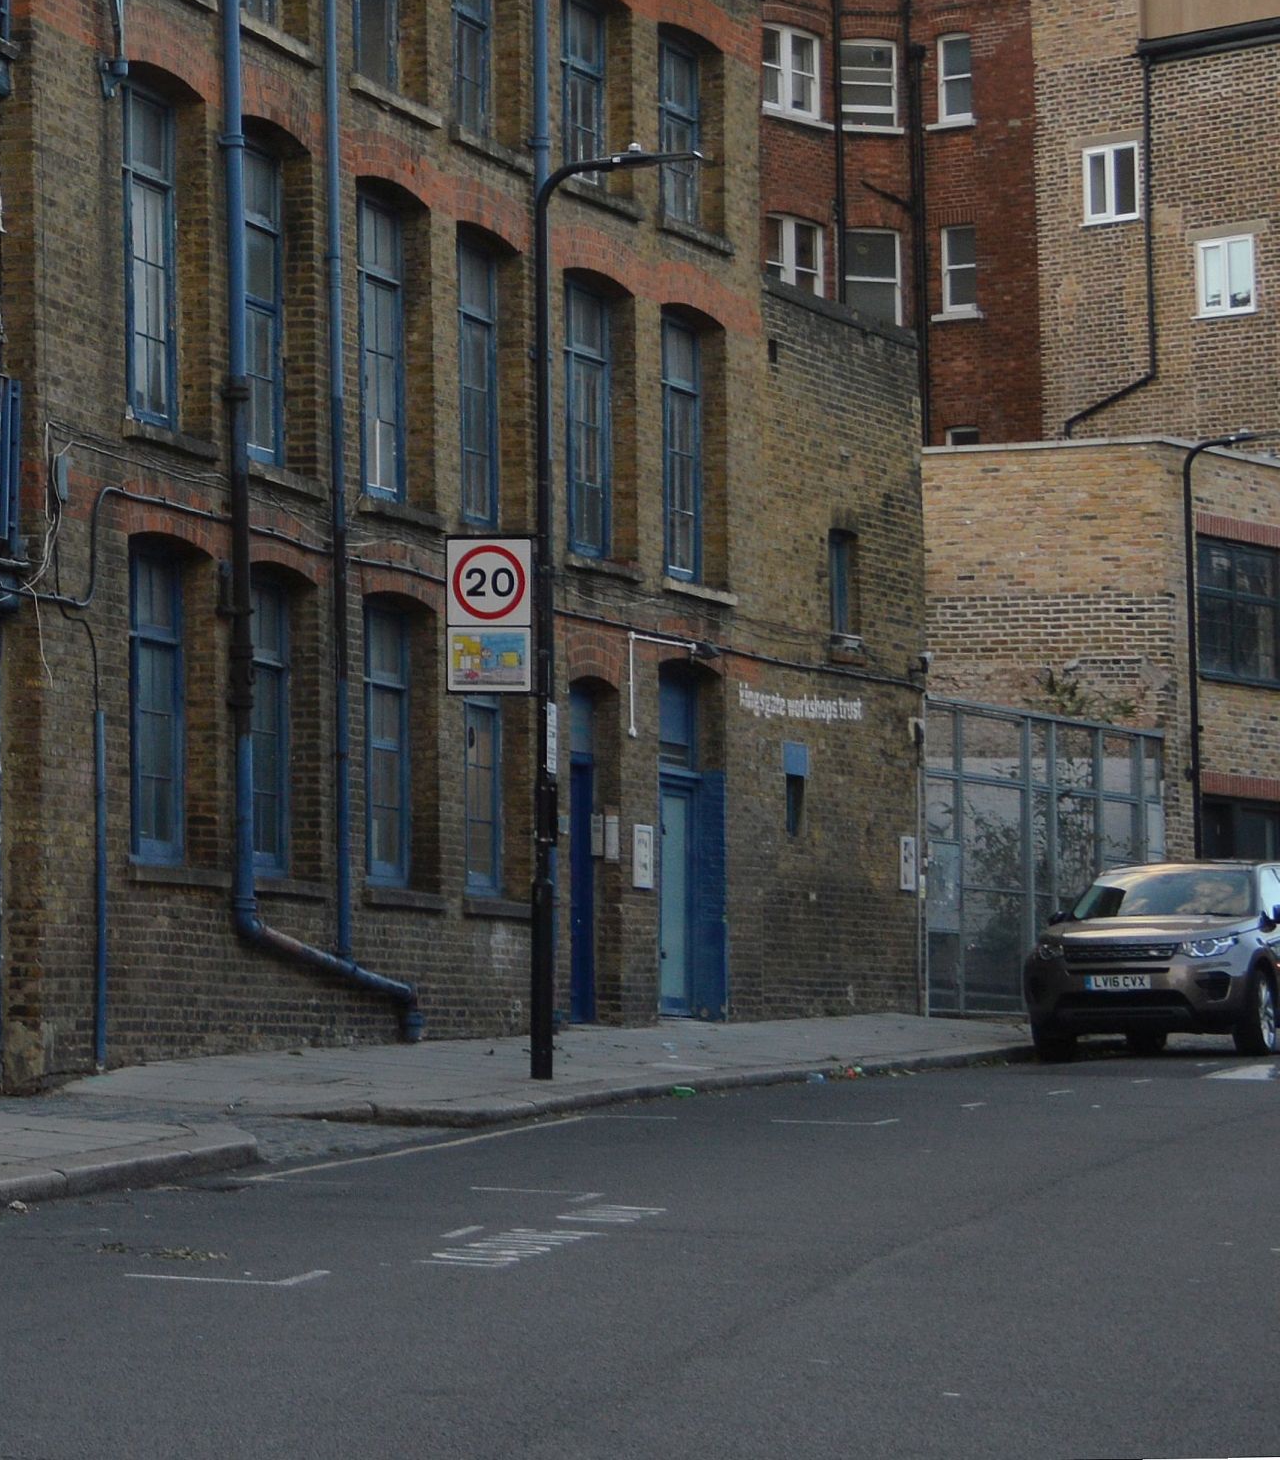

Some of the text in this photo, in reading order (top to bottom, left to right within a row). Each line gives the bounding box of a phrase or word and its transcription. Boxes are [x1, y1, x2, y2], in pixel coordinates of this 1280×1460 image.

[465, 567, 515, 597] 20
[739, 682, 863, 724] kingsgate workshops trust
[1093, 976, 1146, 988] LV16 CVX
